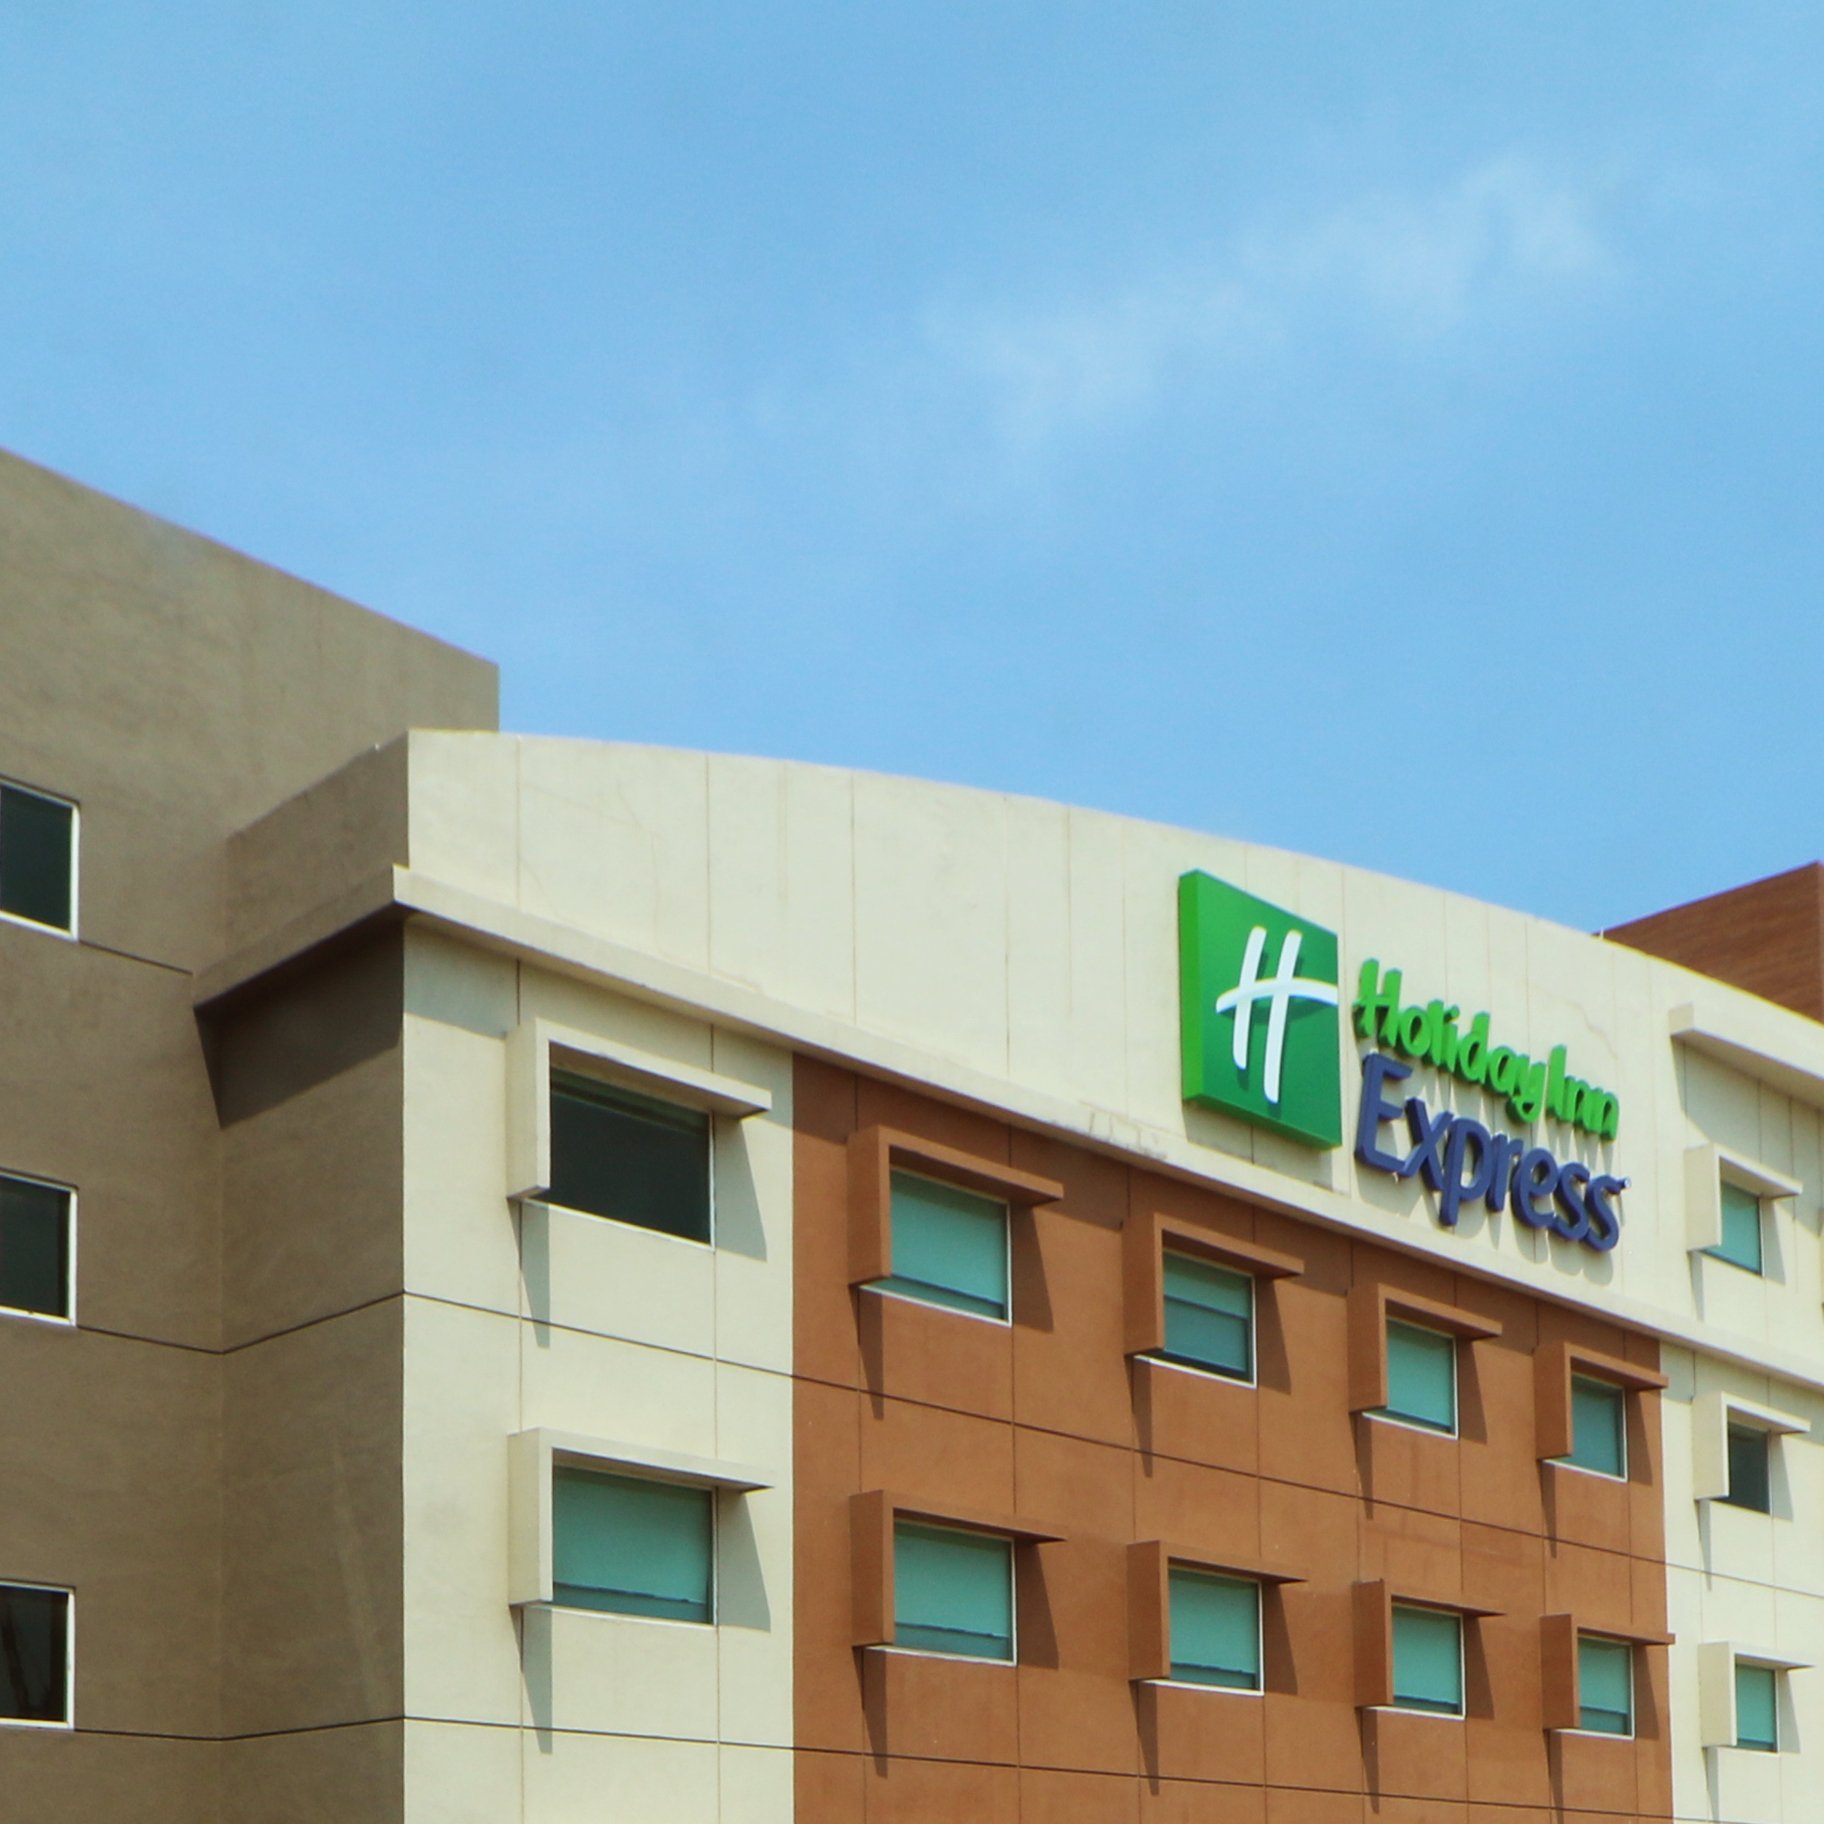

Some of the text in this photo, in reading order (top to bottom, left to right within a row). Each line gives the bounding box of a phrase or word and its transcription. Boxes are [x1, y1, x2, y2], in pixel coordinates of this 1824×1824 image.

[1354, 958, 1619, 1142] Holiday Inn
[1354, 1052, 1626, 1254] Express
